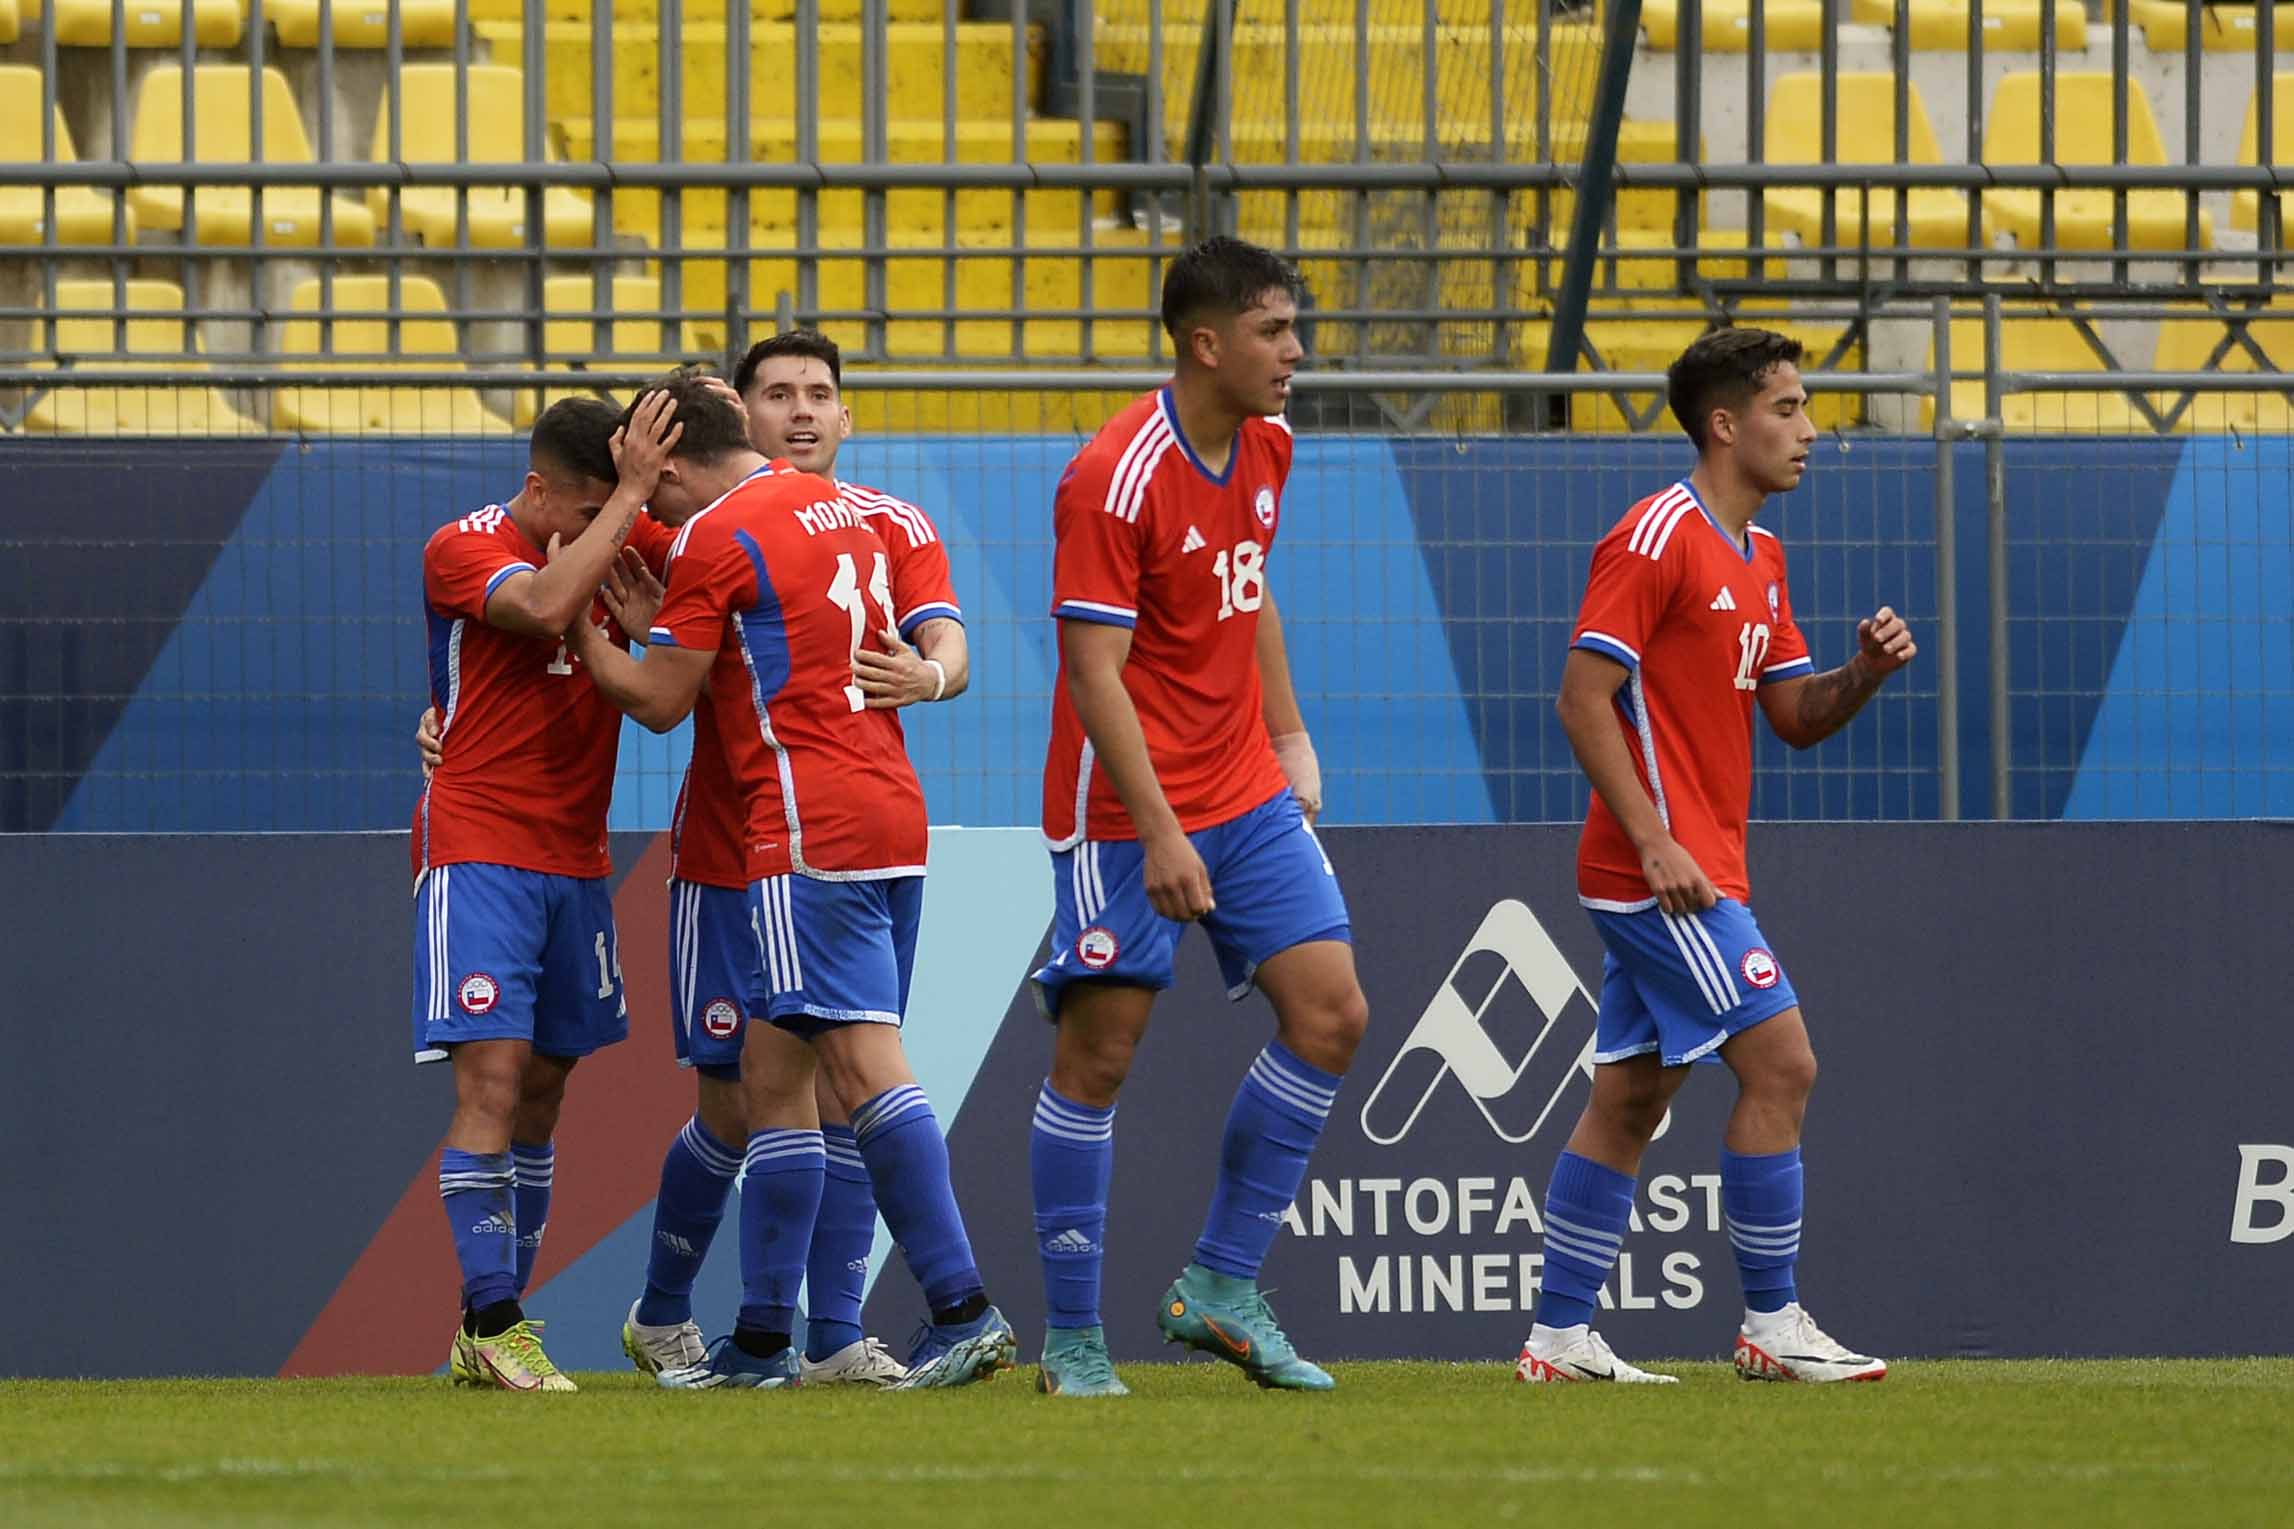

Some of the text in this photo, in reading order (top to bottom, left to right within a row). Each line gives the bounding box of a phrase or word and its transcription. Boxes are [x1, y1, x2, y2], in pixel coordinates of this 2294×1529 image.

[1212, 541, 1265, 621] 18
[826, 552, 900, 713] 11
[1733, 622, 1770, 691] 10
